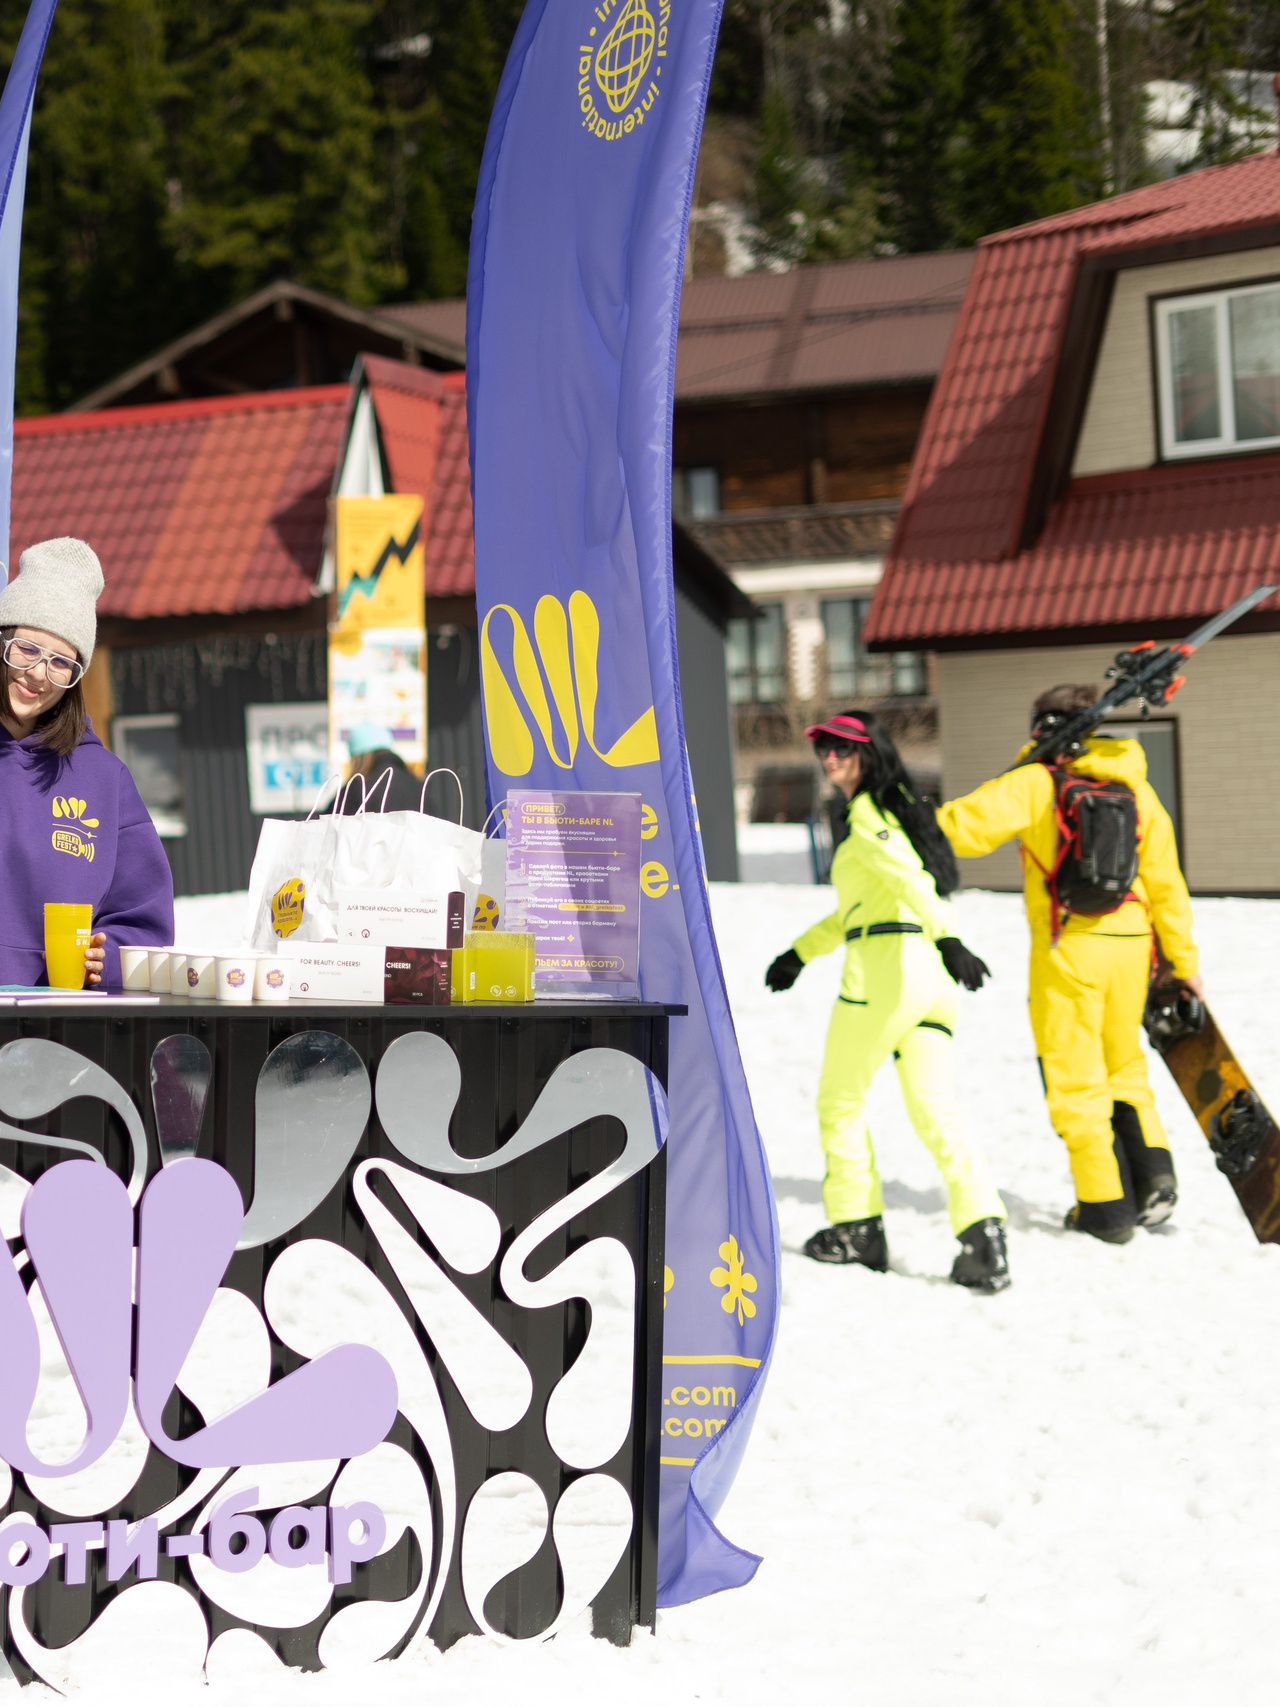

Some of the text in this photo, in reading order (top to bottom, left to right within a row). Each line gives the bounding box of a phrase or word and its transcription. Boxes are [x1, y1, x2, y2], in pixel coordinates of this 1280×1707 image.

[526, 804, 562, 814] ПРИВЕТ,
[522, 816, 614, 826] ТЫ В БЬЮТИ-БАРЕ NL
[57, 840, 72, 851] FEST
[386, 962, 411, 970] CHEERS!
[561, 959, 572, 967] ЗА
[574, 960, 618, 968] КРАСОТУ!
